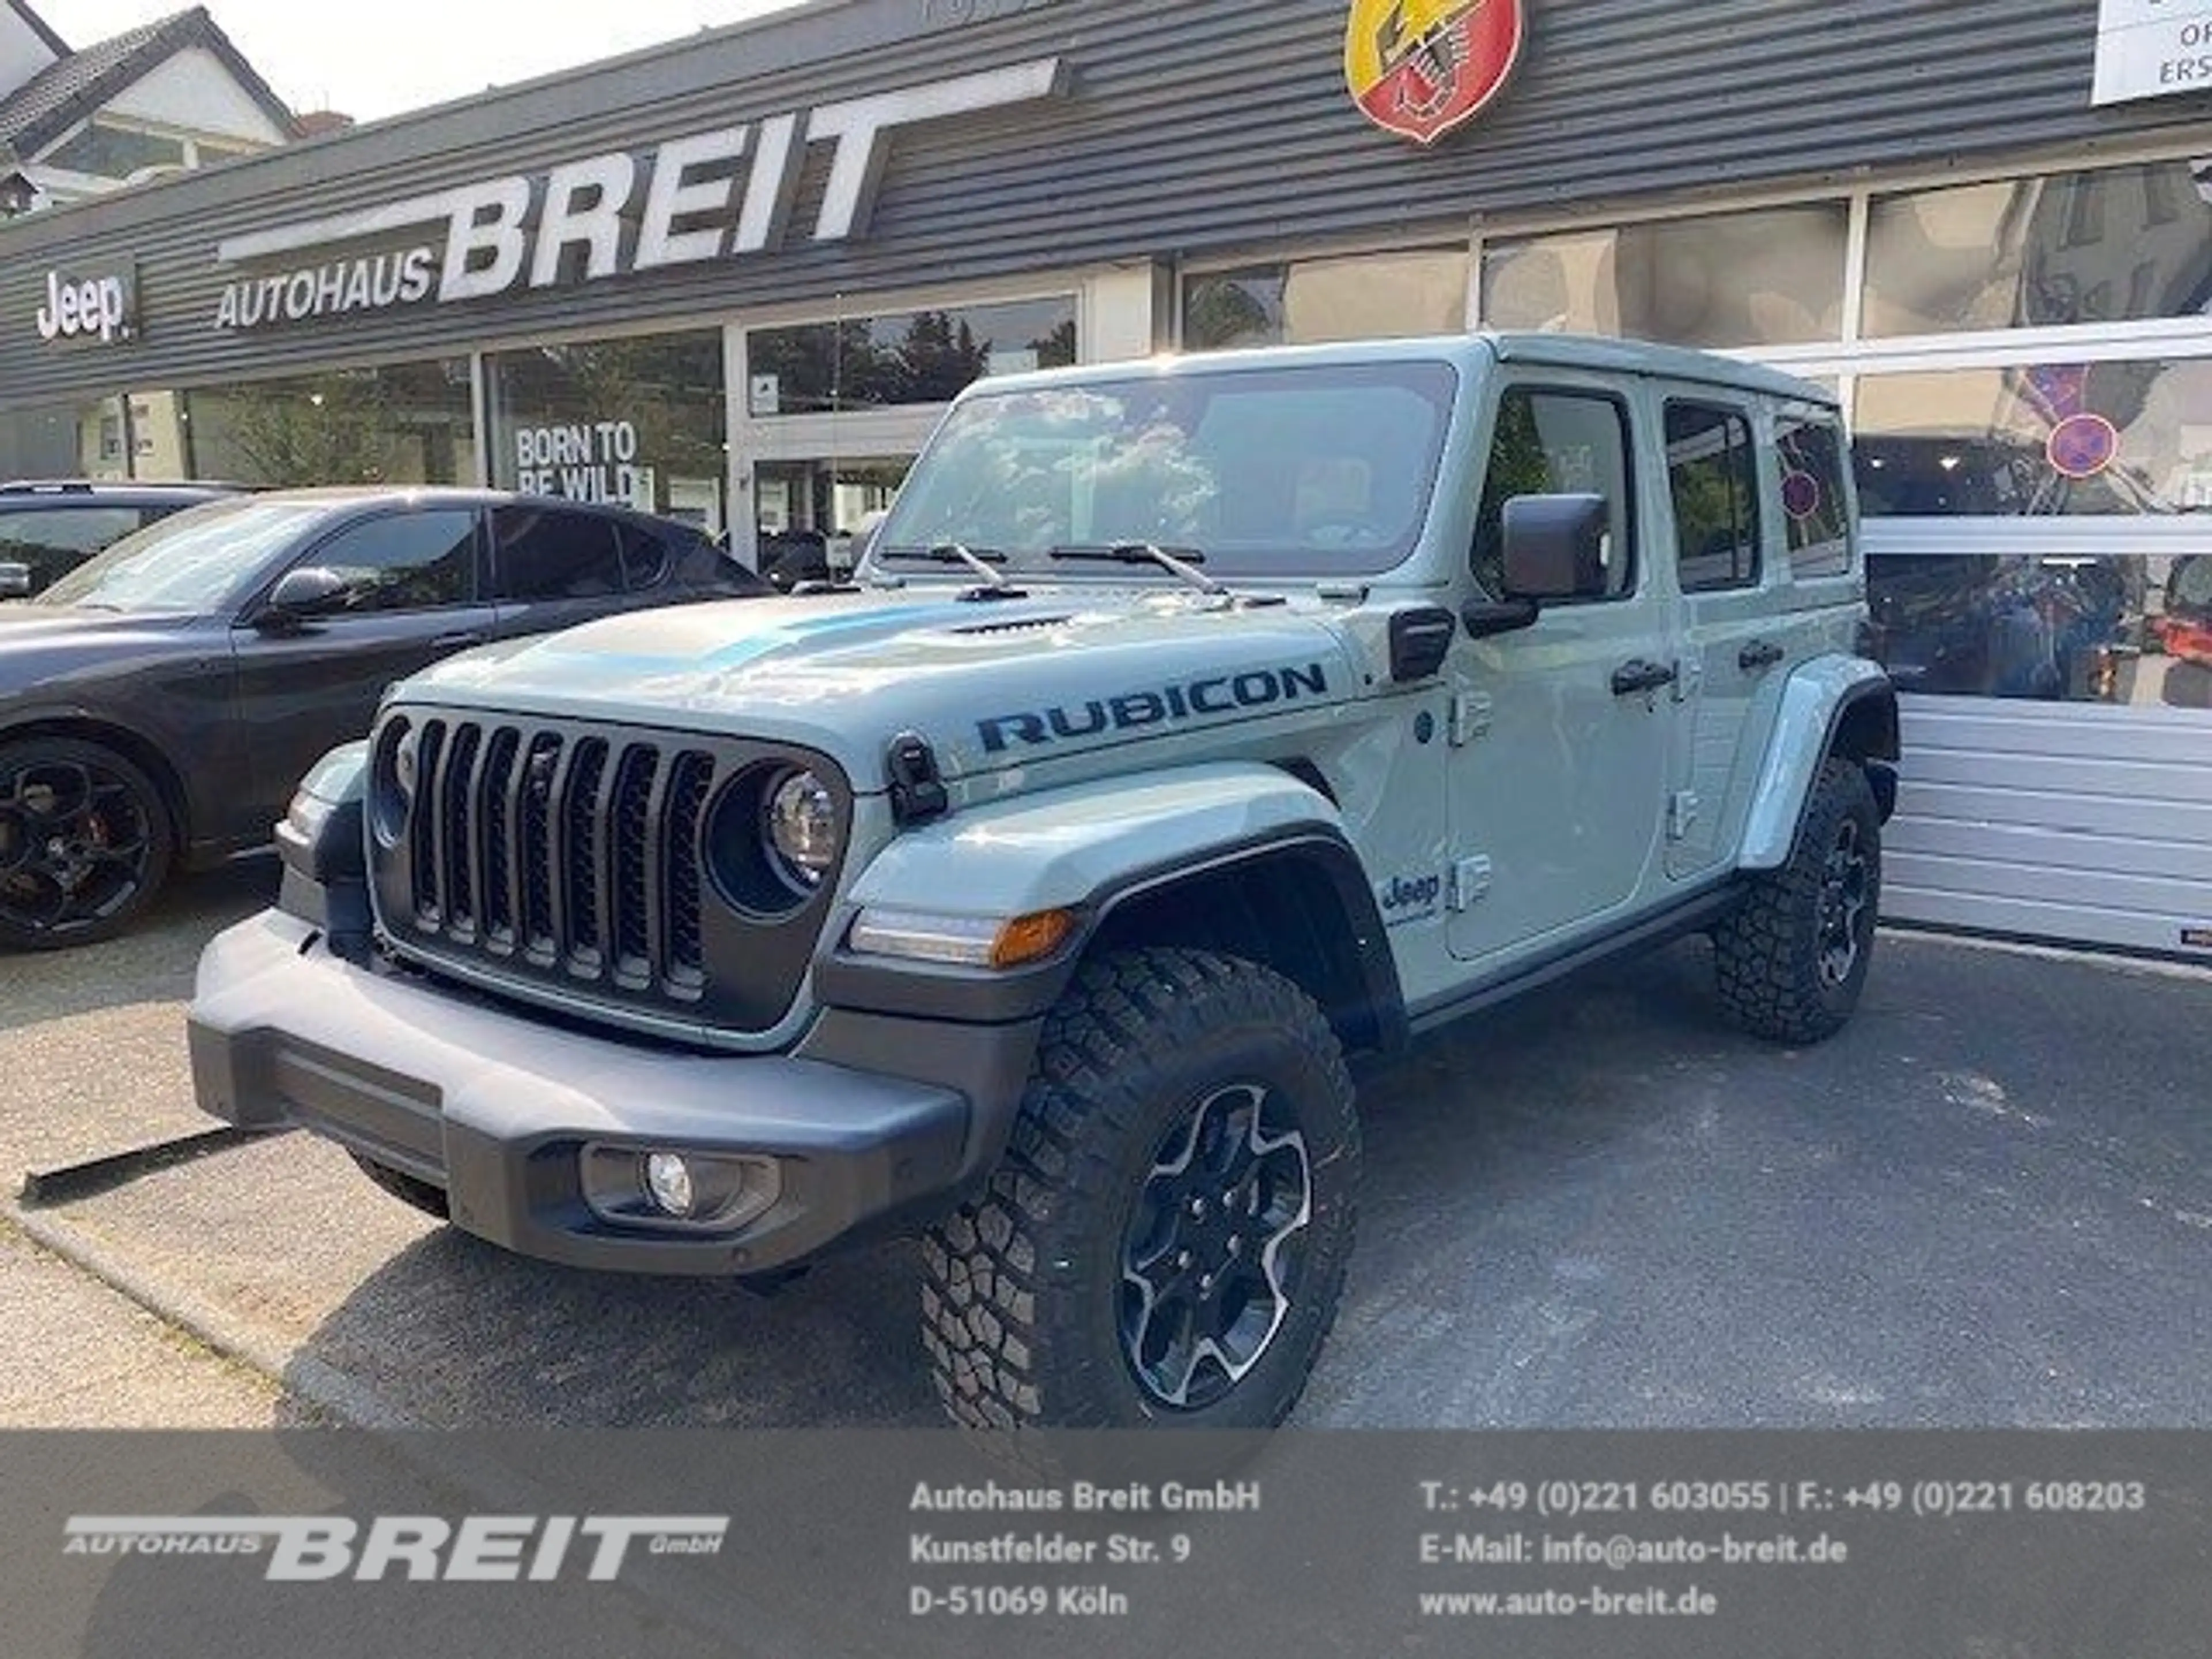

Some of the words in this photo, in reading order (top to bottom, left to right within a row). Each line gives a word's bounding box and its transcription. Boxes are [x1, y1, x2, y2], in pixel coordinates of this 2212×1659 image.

[214, 248, 433, 329] AUTOHAUS
[439, 58, 1061, 302] BREIT
[37, 271, 123, 340] Jeep
[518, 425, 591, 467] BORN
[596, 421, 635, 461] TO
[520, 469, 554, 495] BE
[560, 464, 634, 503] WILD
[976, 663, 1327, 752] RUBICON
[1382, 873, 1439, 909] Jeep
